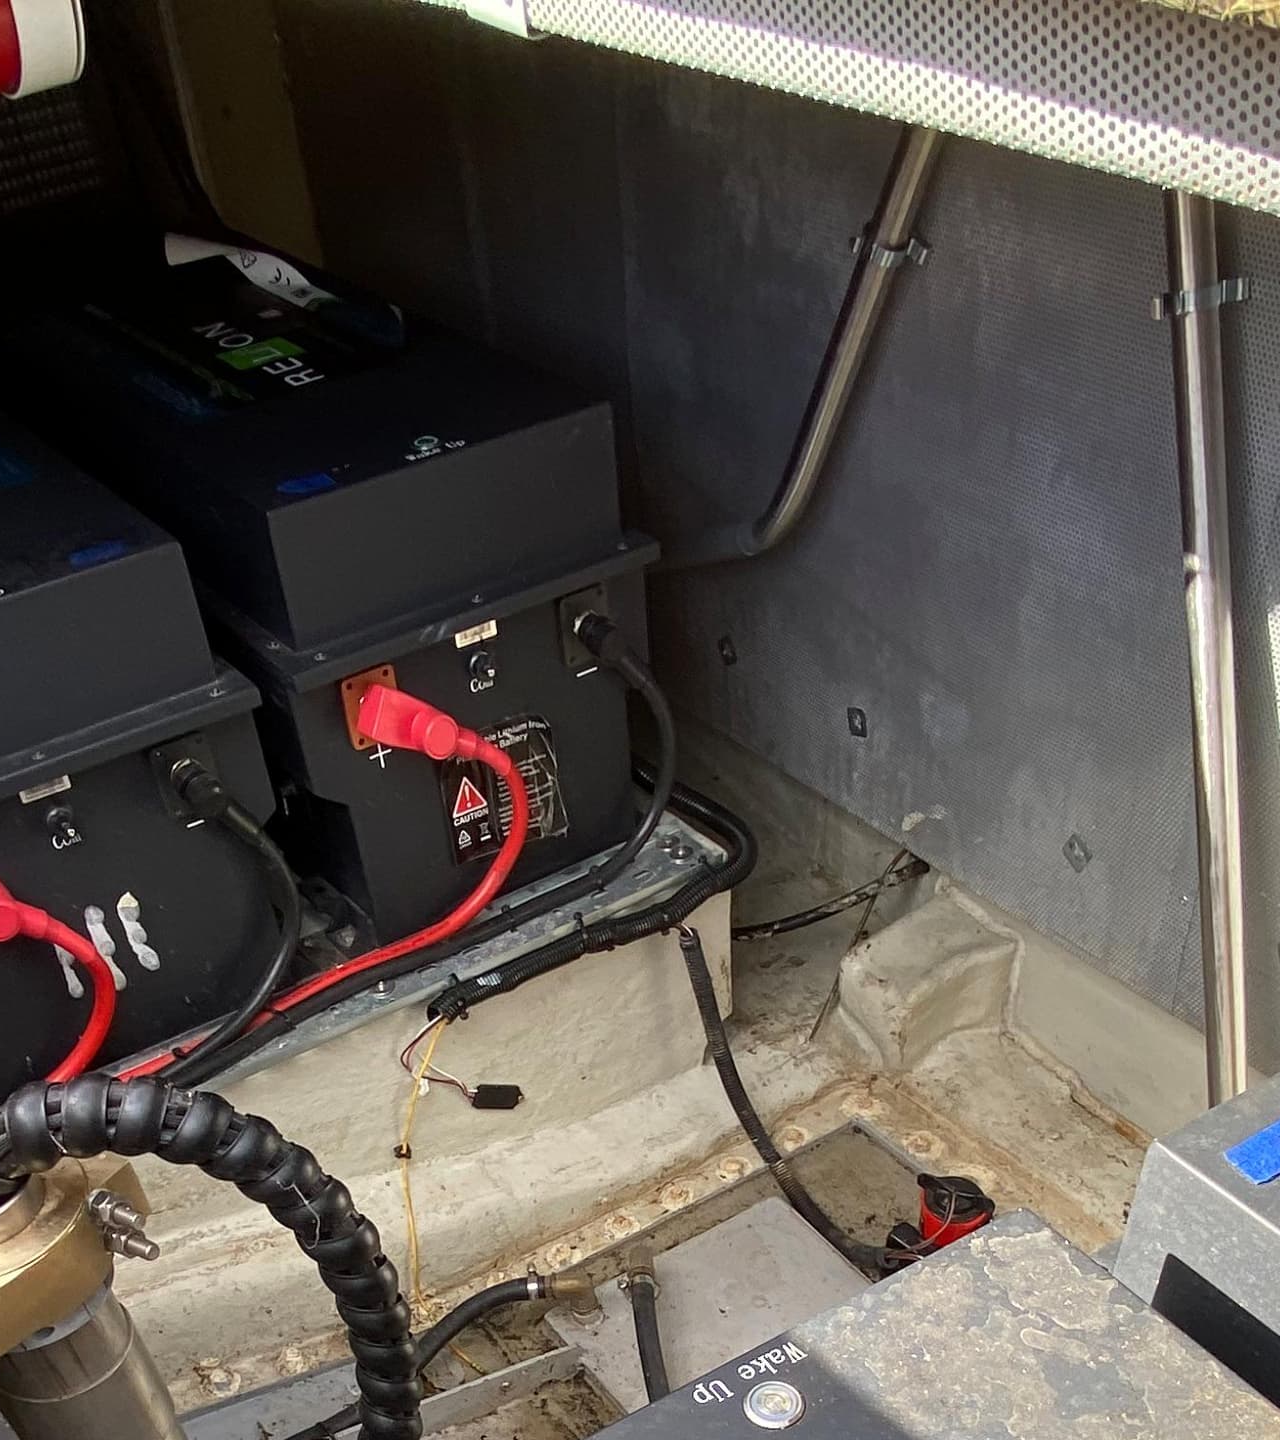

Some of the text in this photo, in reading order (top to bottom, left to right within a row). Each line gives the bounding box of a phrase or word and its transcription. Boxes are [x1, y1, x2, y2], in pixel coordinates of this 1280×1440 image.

[454, 807, 489, 827] CAUTION
[692, 1341, 809, 1405] Wake Up
